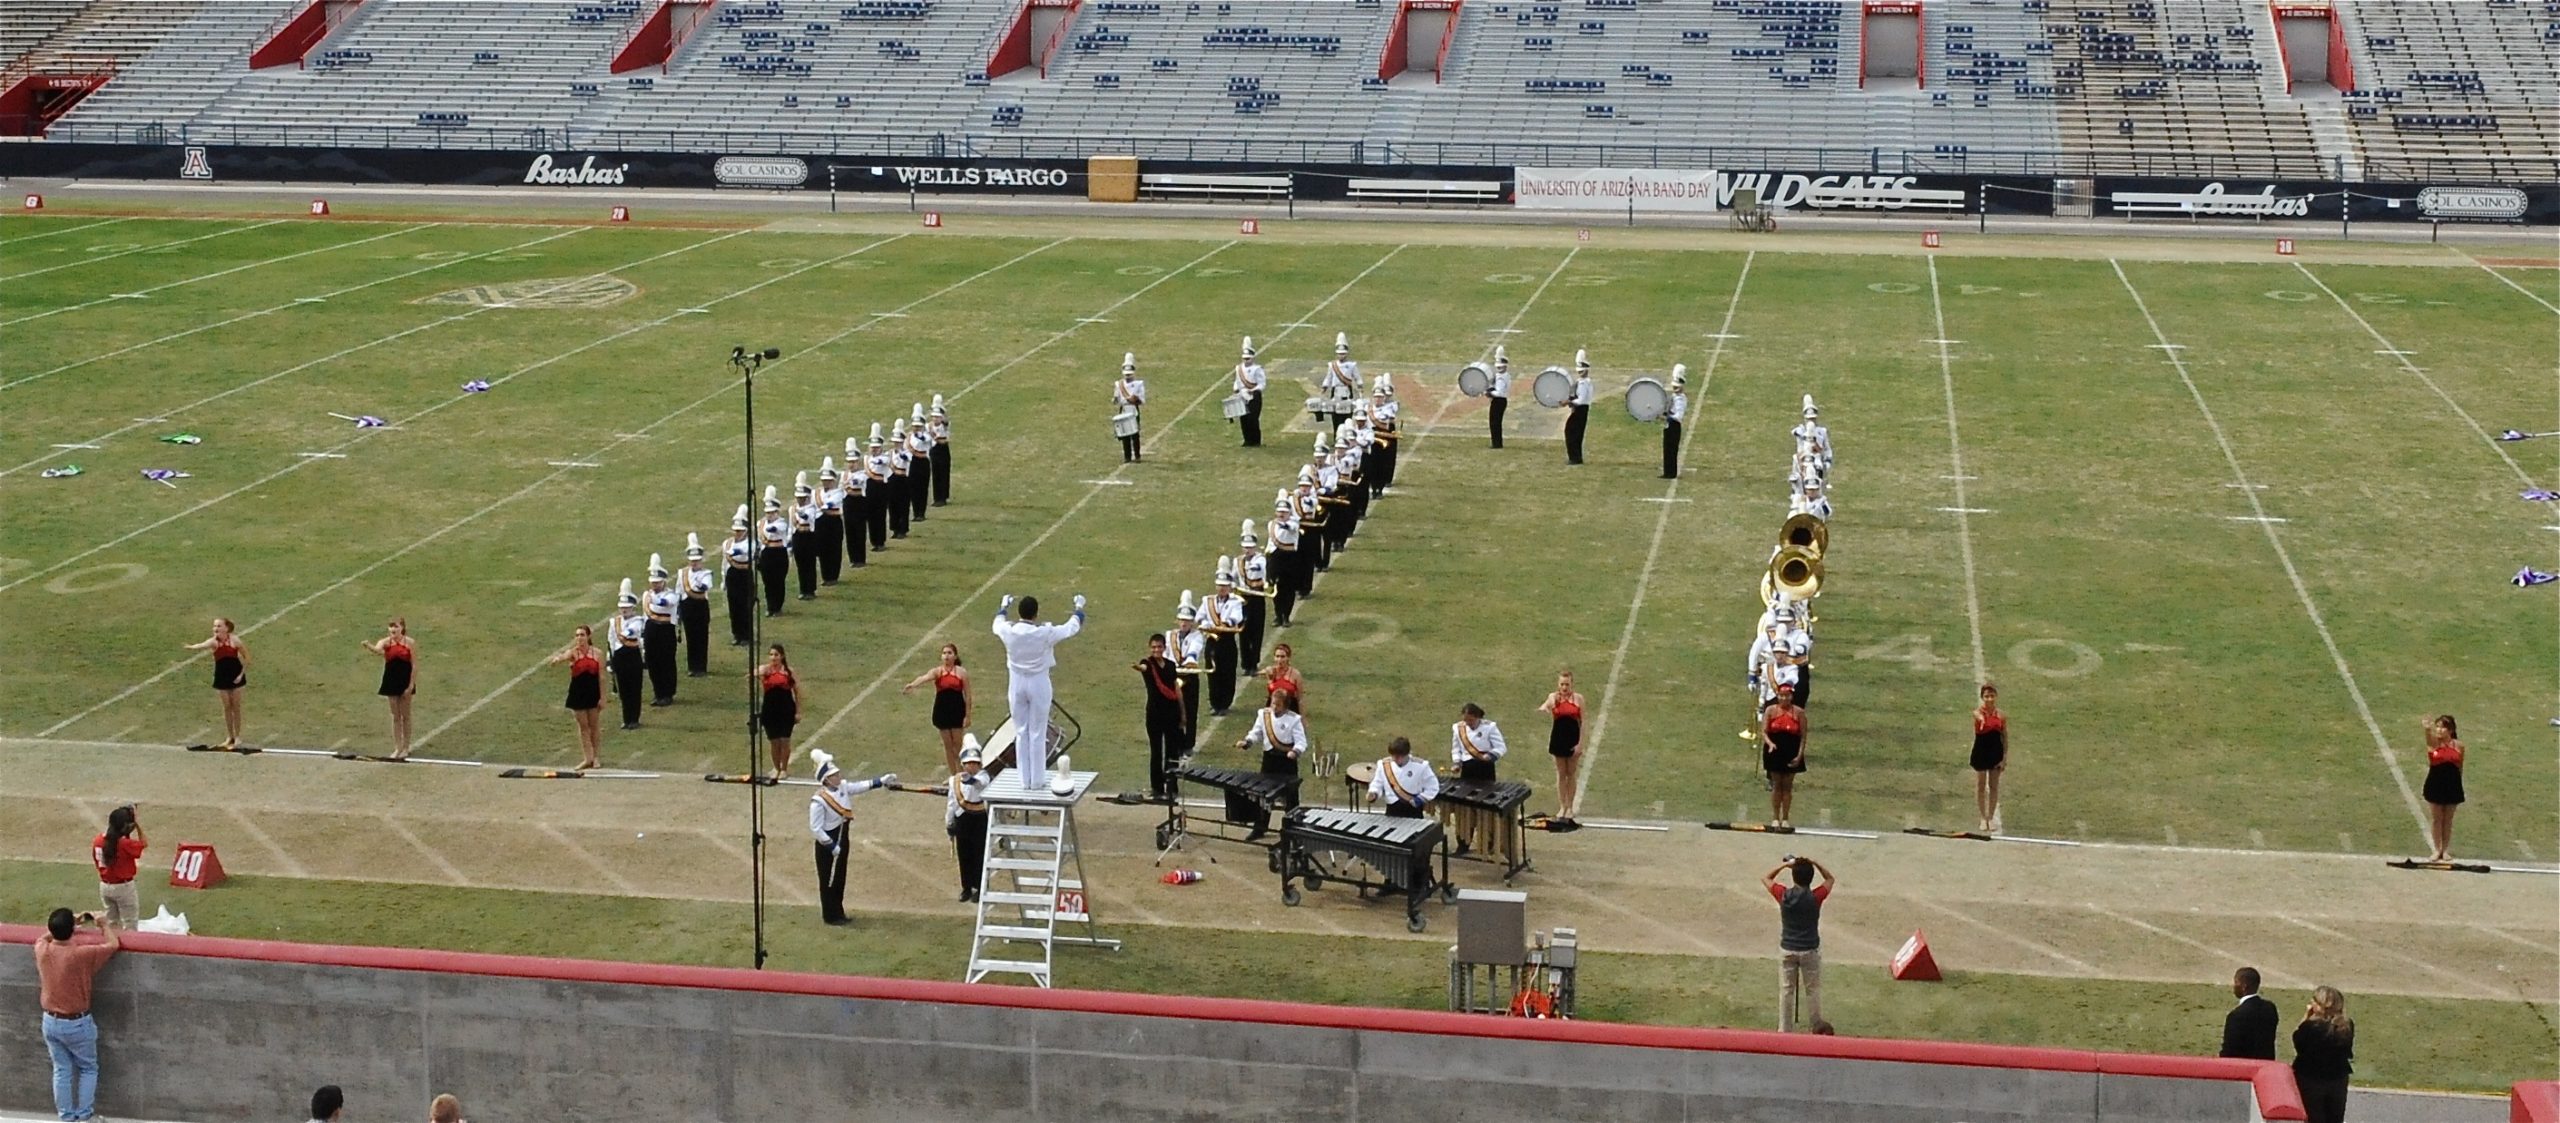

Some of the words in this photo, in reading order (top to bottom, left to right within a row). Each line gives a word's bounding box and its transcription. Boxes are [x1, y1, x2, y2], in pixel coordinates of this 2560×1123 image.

[180, 147, 212, 178] A
[523, 153, 628, 184] Bashas'
[724, 165, 743, 176] SOL
[748, 165, 798, 176] CASINOS
[895, 167, 981, 185] WELLS
[985, 168, 1067, 187] FARGO
[1520, 179, 1582, 196] UNIVERSITY
[1582, 180, 1598, 196] OF
[1600, 181, 1651, 198] ARIZONA
[1653, 182, 1686, 198] BAND
[1688, 182, 1711, 199] DAY
[2428, 196, 2454, 208] SOL
[2457, 196, 2516, 208] CASINOS
[175, 849, 203, 882] 40
[1059, 893, 1083, 913] 50
